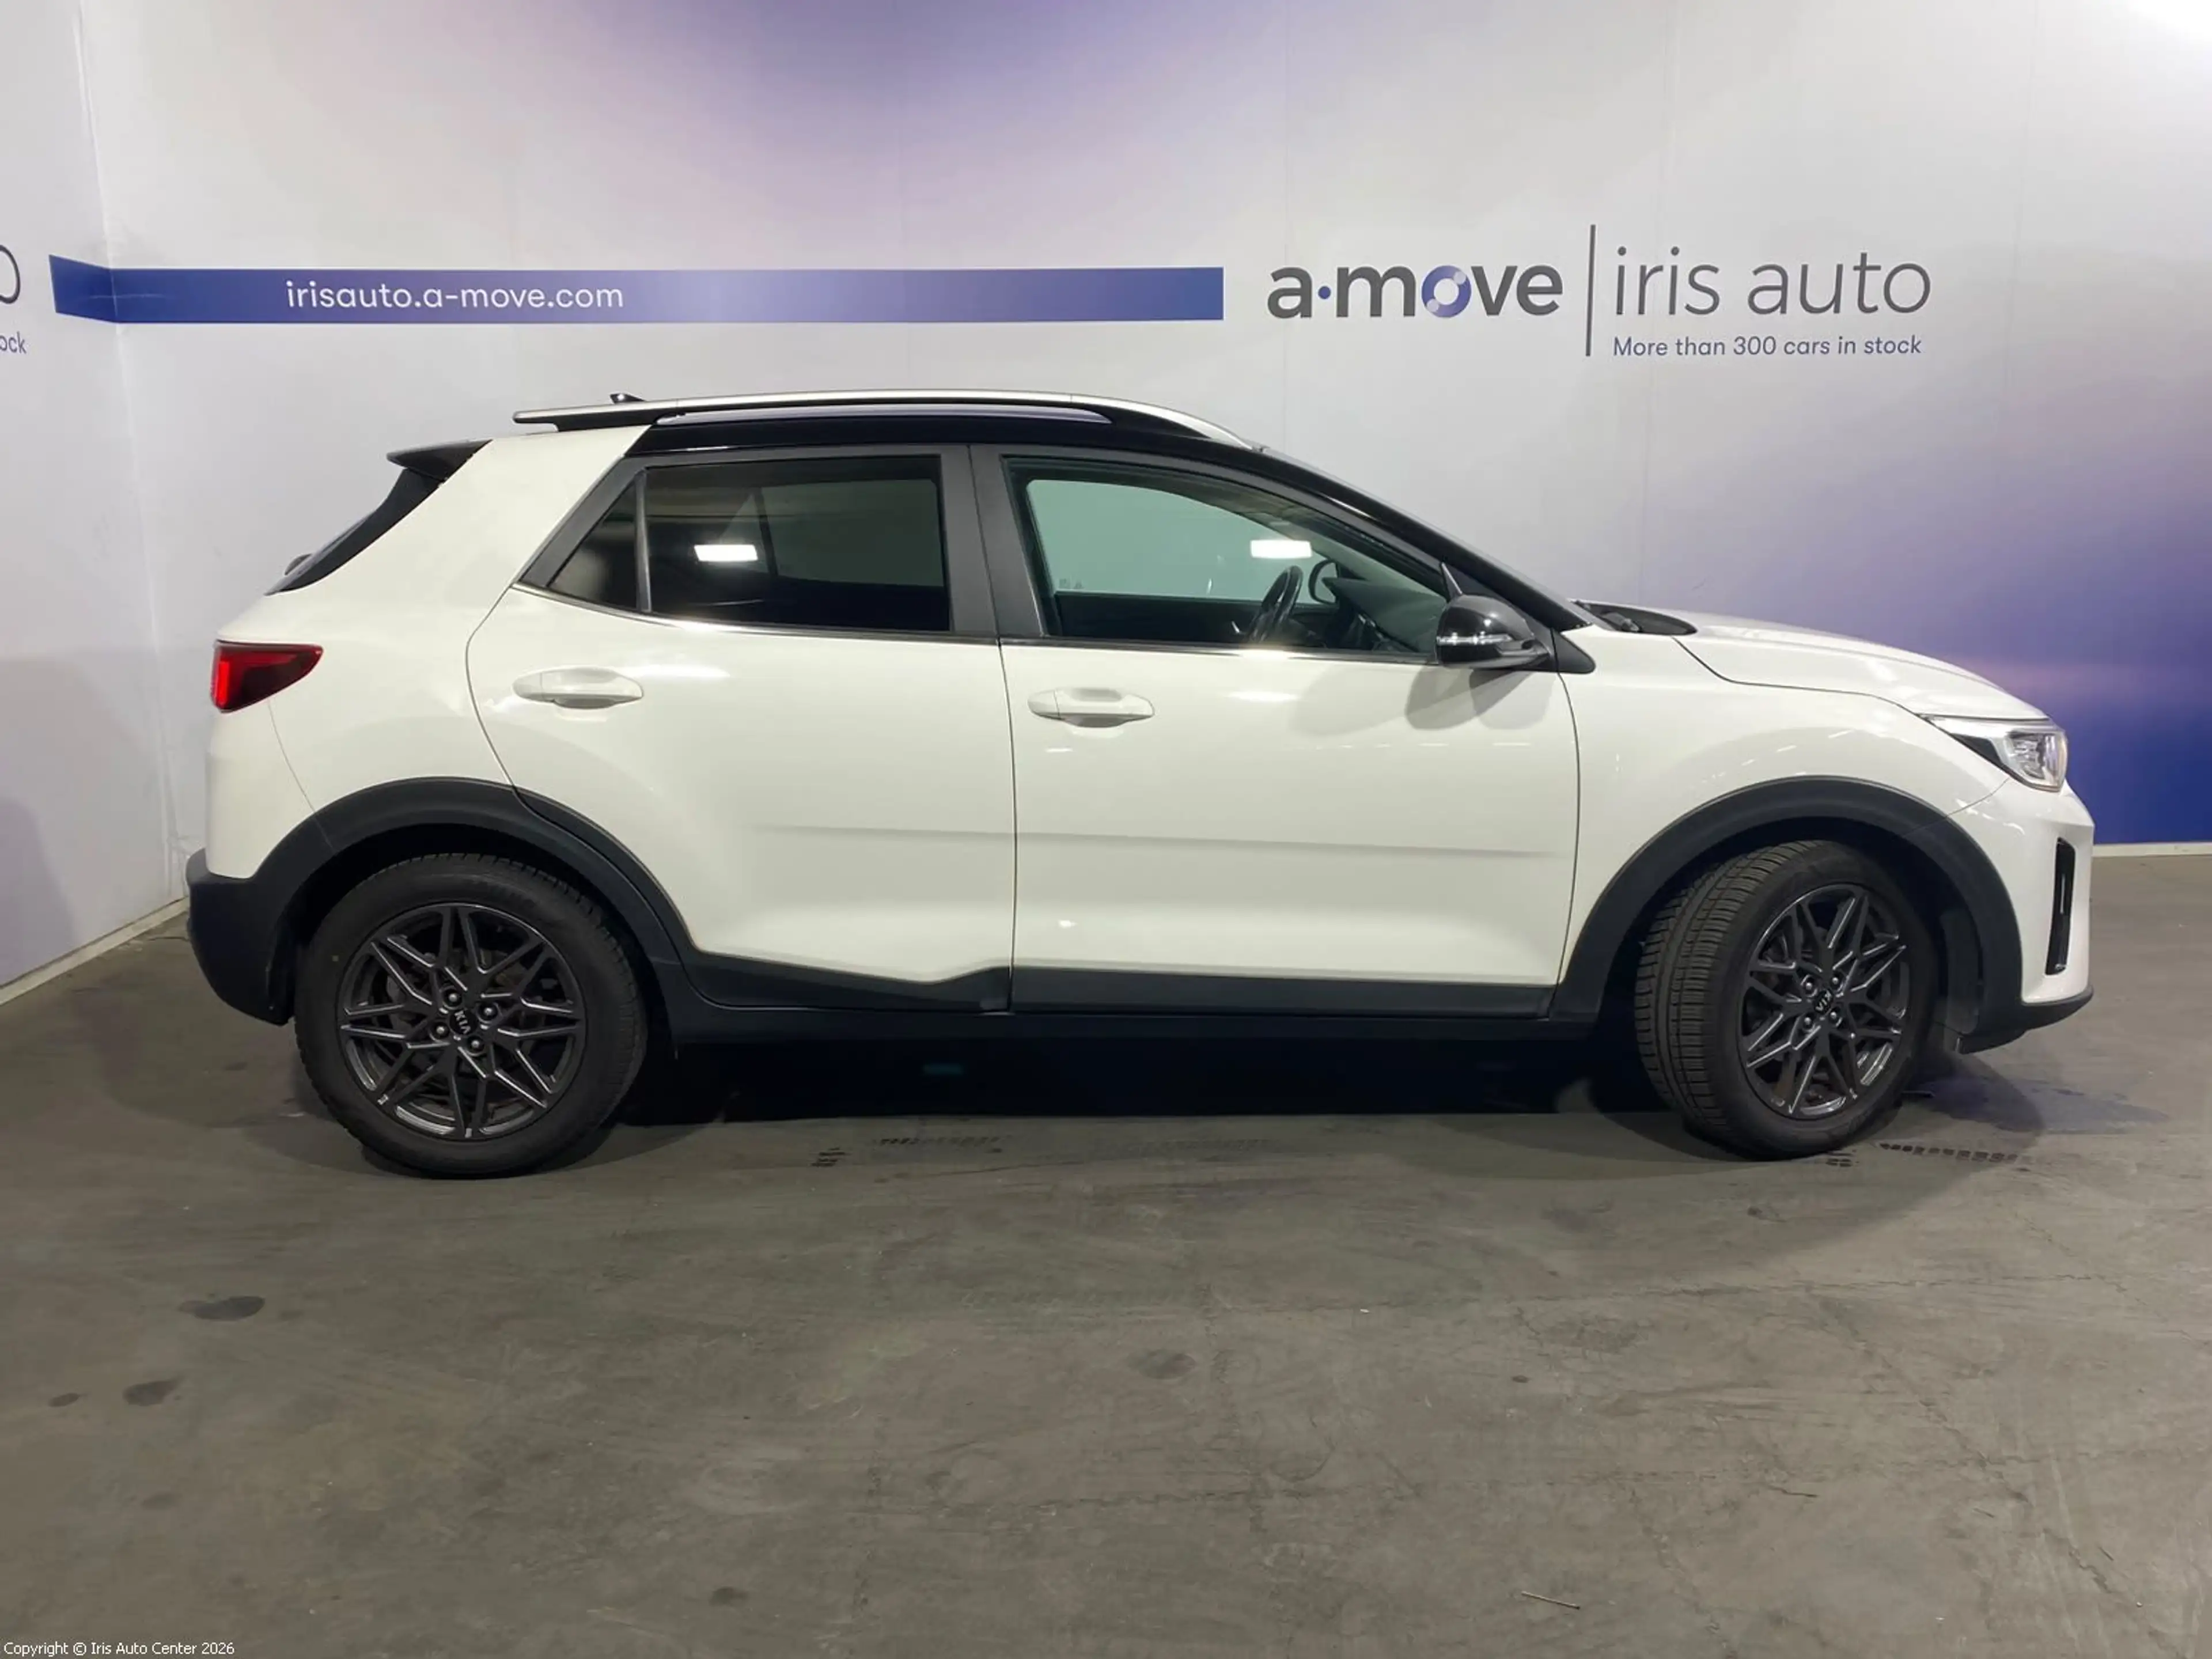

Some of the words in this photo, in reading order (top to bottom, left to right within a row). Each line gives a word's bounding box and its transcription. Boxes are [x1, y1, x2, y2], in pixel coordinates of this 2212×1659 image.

[286, 279, 623, 308] irisauto.a-move.com
[1615, 245, 1720, 316] iris
[1747, 252, 1931, 316] auto
[1613, 336, 1668, 356] More
[1675, 336, 1725, 356] than
[1733, 336, 1777, 355] 300
[1783, 340, 1830, 355] cars
[1838, 335, 1856, 355] in
[1863, 334, 1922, 355] stock
[454, 1010, 471, 1034] KIA
